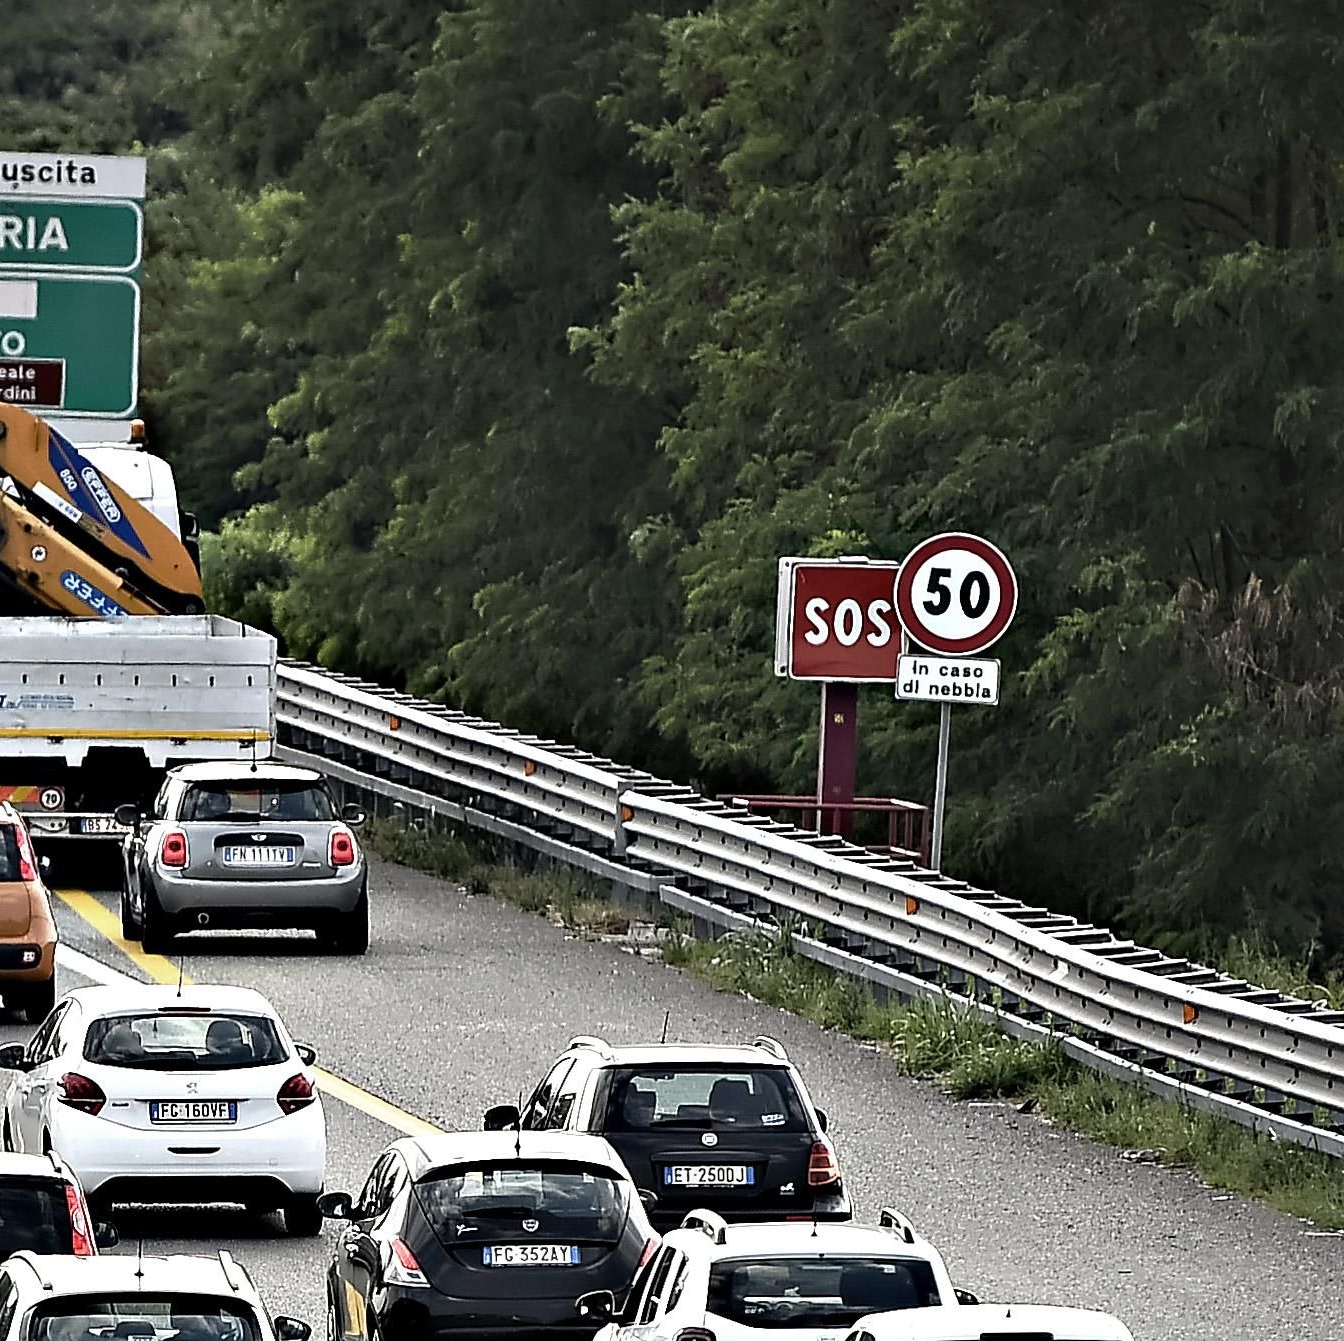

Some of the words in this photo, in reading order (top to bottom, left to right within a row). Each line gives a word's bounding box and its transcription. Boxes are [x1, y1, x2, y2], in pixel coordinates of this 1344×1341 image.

[2, 159, 96, 184] uscita
[59, 468, 78, 490] 850
[84, 469, 118, 520] EFFER
[923, 567, 990, 619] 50
[805, 597, 892, 647] SOS
[939, 663, 983, 678] caso
[903, 680, 919, 694] di
[929, 680, 992, 698] nebbia
[161, 1103, 178, 1118] FC
[185, 1103, 227, 1118] 160VF
[674, 1167, 692, 1183] ET
[699, 1167, 745, 1182] 250DJ
[494, 1246, 513, 1262] FG
[519, 1246, 568, 1262] 352AY
